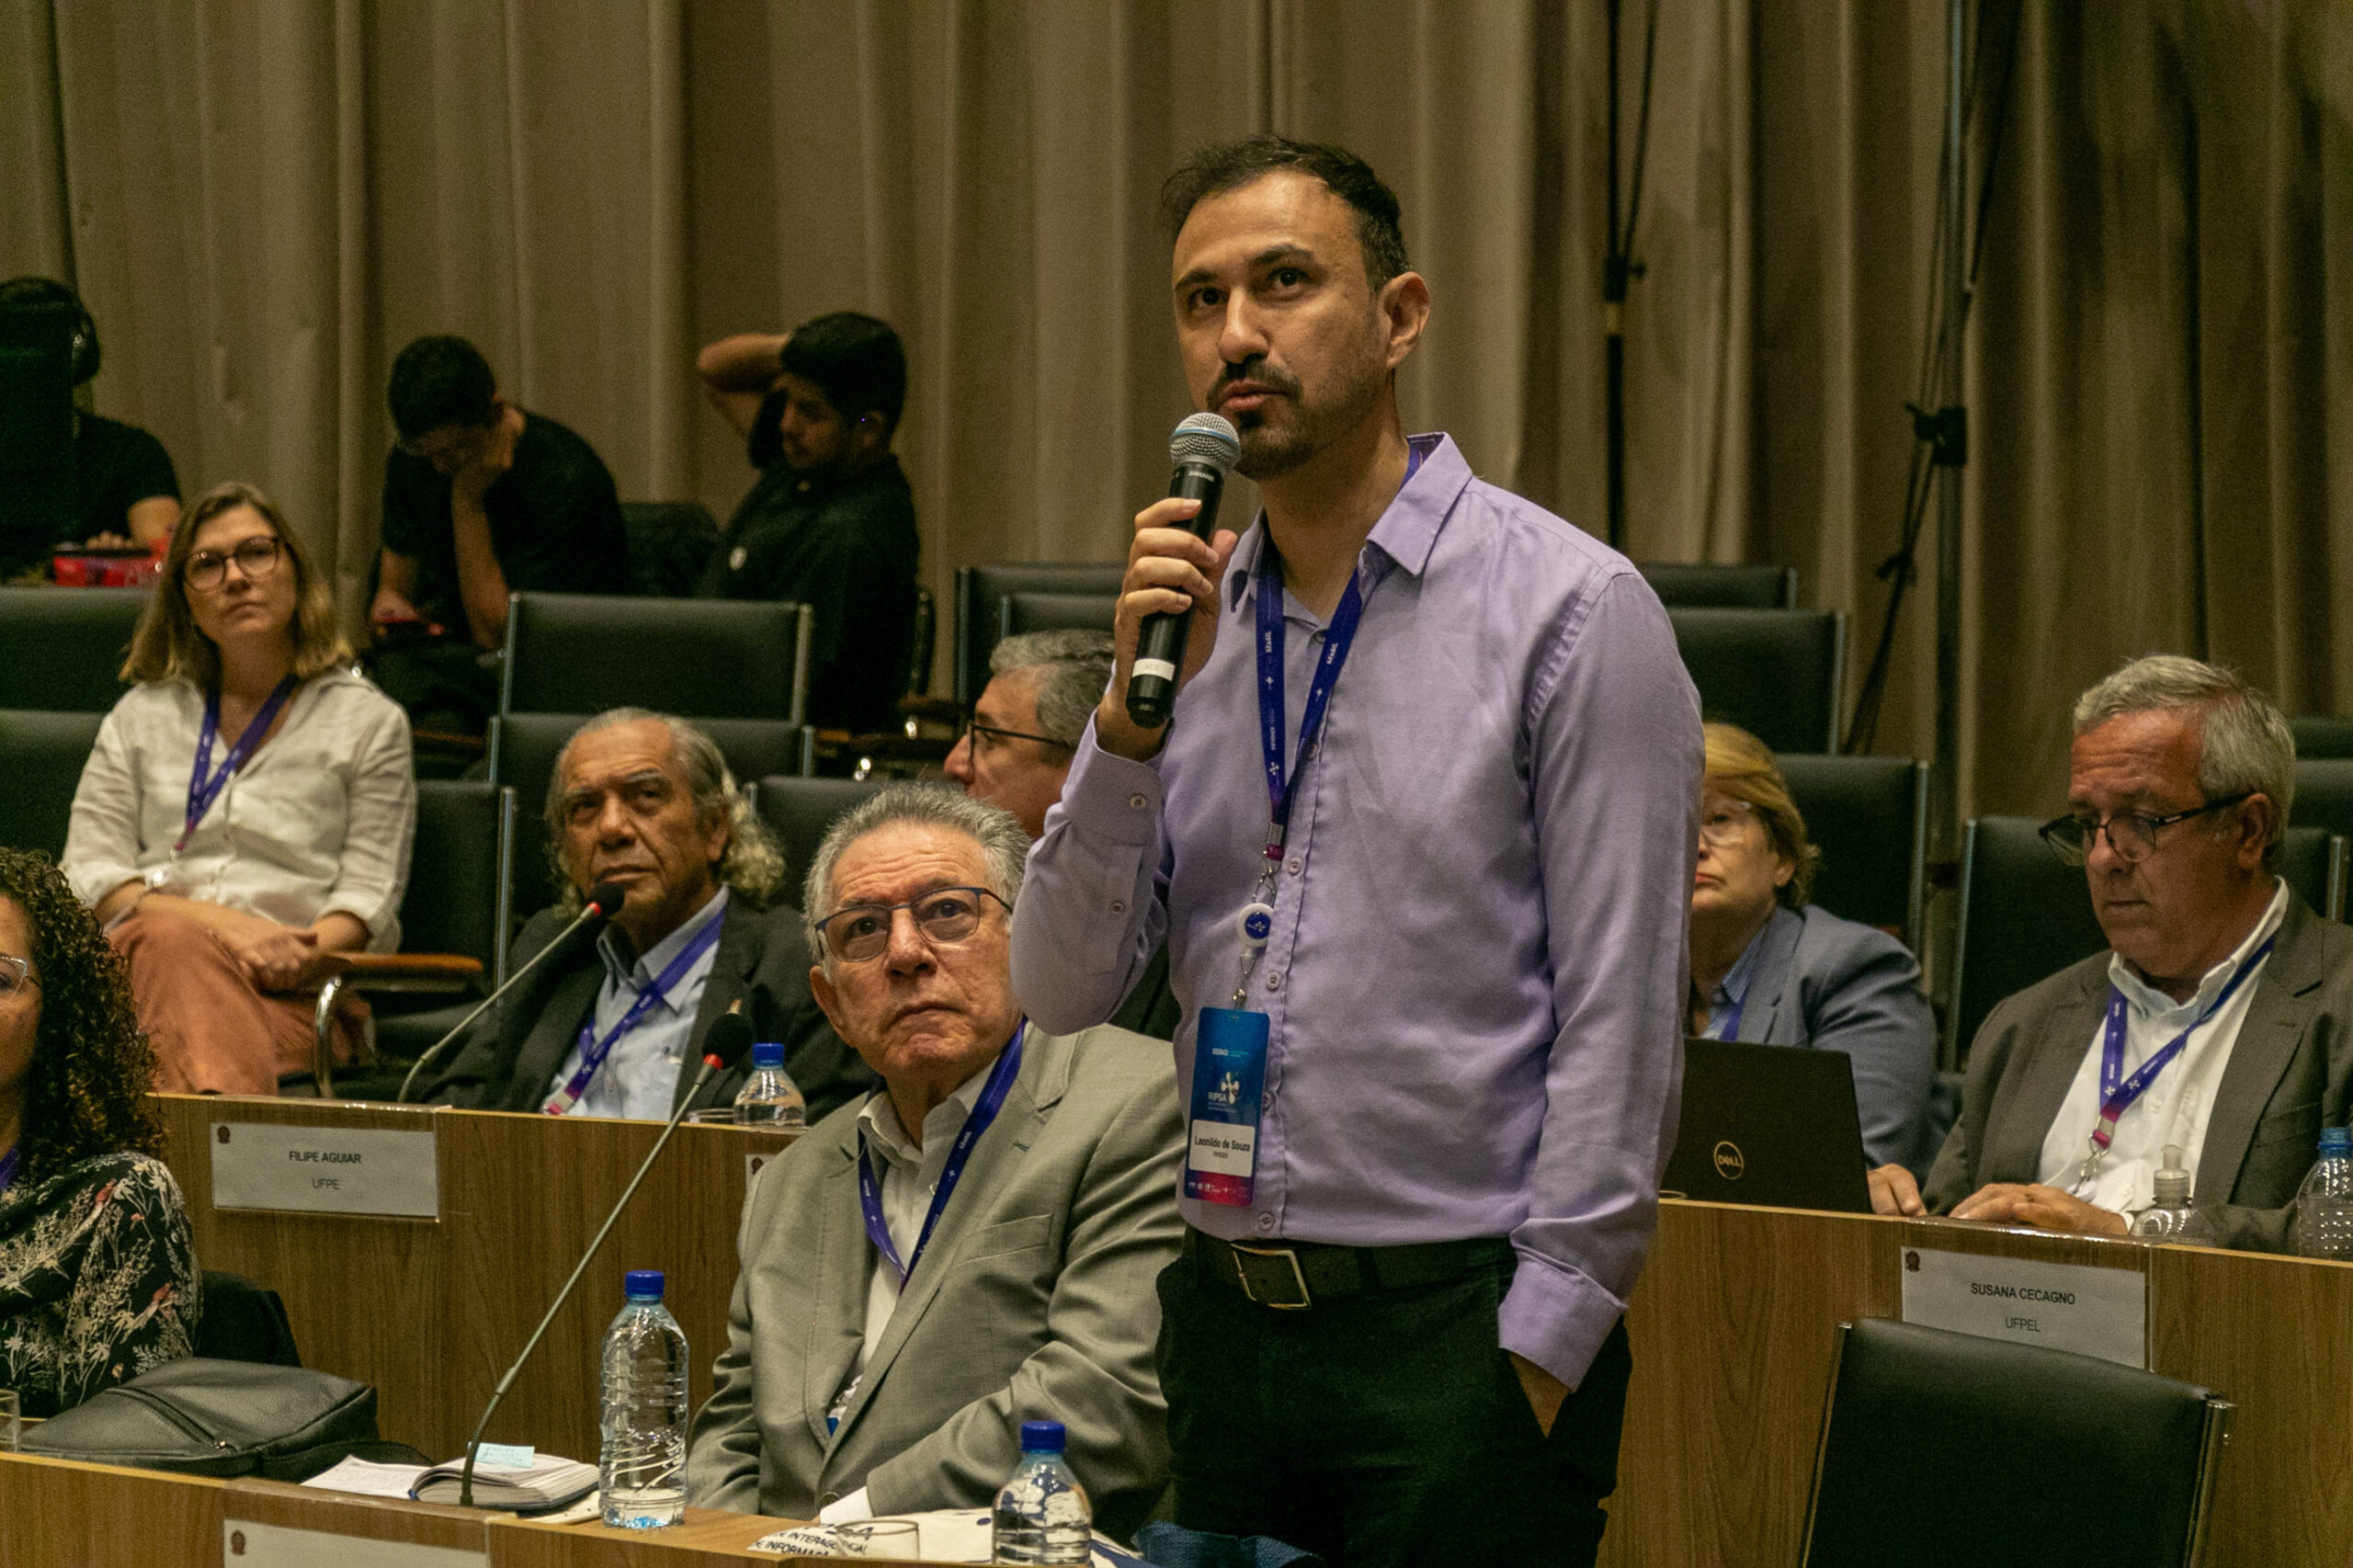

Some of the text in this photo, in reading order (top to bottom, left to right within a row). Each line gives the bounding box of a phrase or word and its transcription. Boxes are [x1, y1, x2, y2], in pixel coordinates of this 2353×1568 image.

[289, 1151, 362, 1165] FILIPE AGUIAR
[312, 1177, 340, 1190] UFPE
[1970, 1282, 2075, 1305] SUSANA CECAGNO
[2005, 1316, 2041, 1333] UFPEL
